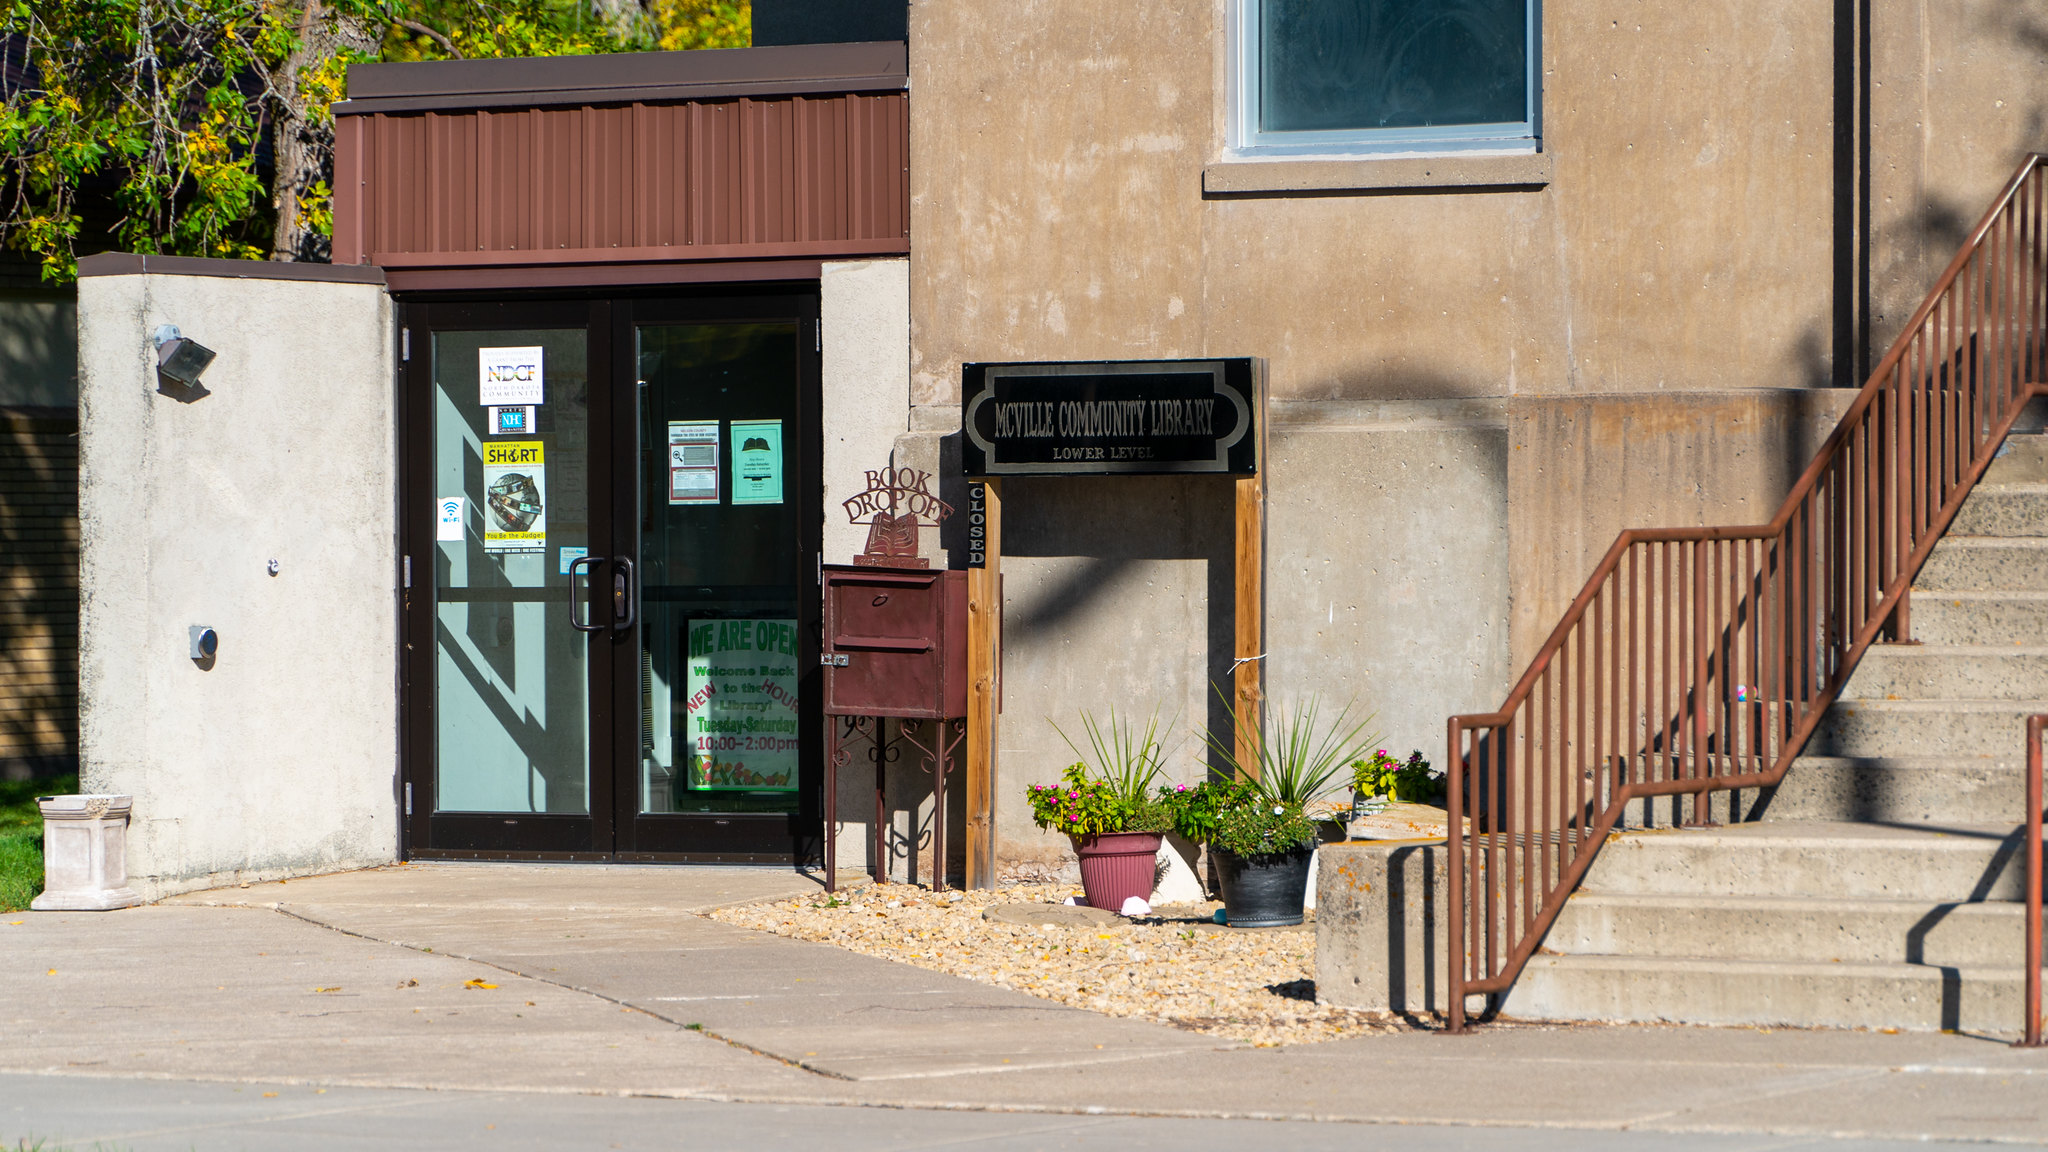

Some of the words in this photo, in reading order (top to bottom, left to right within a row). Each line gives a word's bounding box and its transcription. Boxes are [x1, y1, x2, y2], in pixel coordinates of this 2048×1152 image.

[487, 364, 536, 382] NDCF
[994, 401, 1054, 438] MCVILLE
[1058, 399, 1146, 438] COMMUNITY
[1150, 398, 1215, 436] LIBRARY
[1053, 447, 1105, 460] LOWER
[1110, 446, 1155, 459] LEVEL
[864, 467, 932, 494] BOOK
[842, 490, 906, 524] DROP
[908, 493, 956, 523] OFF
[969, 488, 986, 564] CLOSED
[691, 624, 713, 659] WE
[718, 621, 752, 652] ARE
[756, 621, 798, 658] OPEN
[694, 666, 756, 677] Welcome
[759, 665, 795, 677] Back
[687, 681, 717, 714] NEW
[723, 682, 738, 693] to
[741, 682, 761, 693] the
[719, 700, 773, 713] Library!
[697, 716, 797, 735] Tuesday-Saturday
